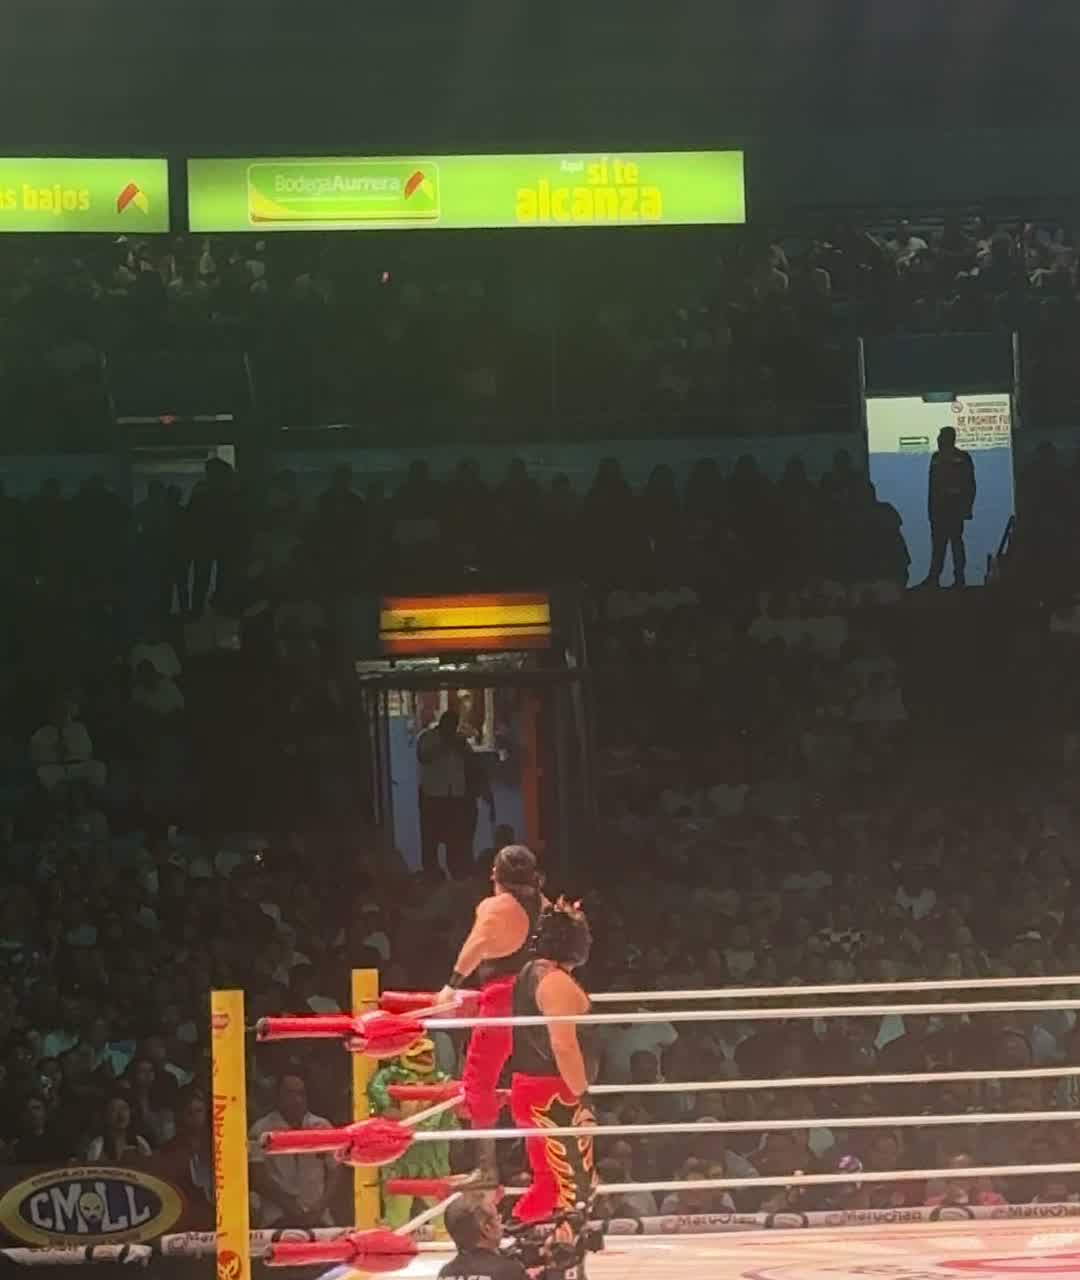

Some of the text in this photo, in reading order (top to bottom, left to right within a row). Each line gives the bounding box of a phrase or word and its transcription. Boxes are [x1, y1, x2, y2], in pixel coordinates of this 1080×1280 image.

[586, 157, 609, 185] si
[613, 159, 638, 185] te
[23, 185, 89, 214] bajos
[516, 178, 662, 224] alcanza
